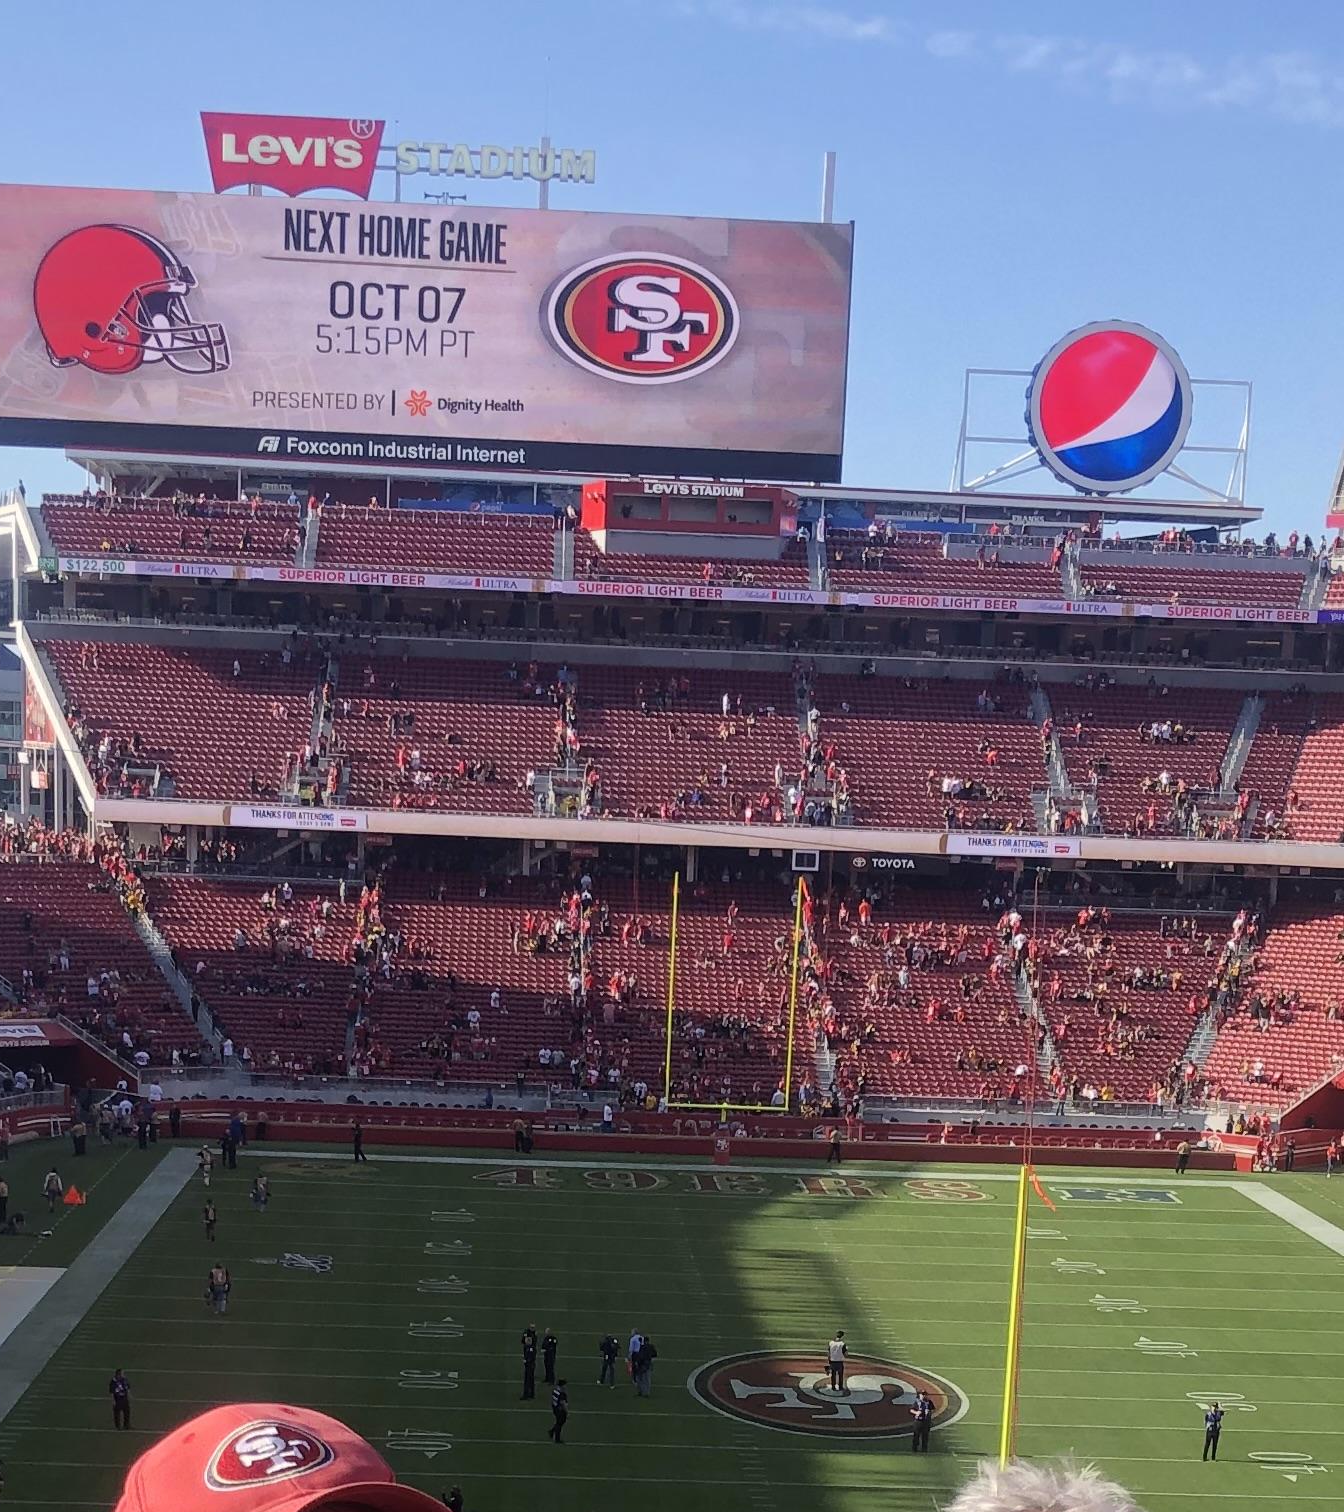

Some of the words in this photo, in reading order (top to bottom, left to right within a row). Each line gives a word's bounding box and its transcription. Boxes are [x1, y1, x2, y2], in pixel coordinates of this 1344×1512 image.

[395, 141, 597, 185] STADIUM
[284, 208, 351, 254] NEXT
[358, 214, 432, 260] HOME
[439, 220, 508, 264] GAME
[329, 281, 409, 321] OCT
[418, 286, 467, 324] 07
[606, 275, 710, 363] SF
[315, 323, 428, 356] 5:15PM
[439, 329, 475, 358] PT
[252, 390, 358, 411] PRESENTED
[362, 394, 385, 411] BY
[437, 397, 482, 416] Dignity
[484, 398, 524, 413] Health
[287, 437, 364, 457] Foxconn
[368, 440, 453, 461] Industrial
[457, 445, 526, 465] Internet
[692, 485, 745, 498] STADIUM
[66, 560, 125, 572] $122,500
[181, 566, 218, 576] ULTRA
[278, 568, 346, 583] SUPERIOR
[349, 572, 388, 585] LIGHT
[392, 574, 426, 586] BEER
[481, 579, 518, 590] ULTRA
[578, 582, 644, 596] SUPERIOR
[647, 585, 685, 598] LIGHT
[689, 587, 724, 600] BEER
[778, 592, 815, 602] ULTRA
[873, 594, 940, 608] SUPERIOR
[942, 596, 981, 609] LIGHT
[984, 599, 1018, 611] BEER
[1072, 603, 1108, 613] ULTRA
[1167, 606, 1233, 619] SUPERIOR
[1235, 608, 1273, 620] LIGHT
[1277, 610, 1311, 622] BEER
[250, 809, 282, 819] THANKS
[283, 810, 297, 820] FOR
[298, 812, 335, 821] ATTENDING
[967, 837, 997, 848] THANKS
[998, 838, 1012, 848] FOR
[871, 858, 915, 869] TOYOTA
[234, 1426, 312, 1475] SF
